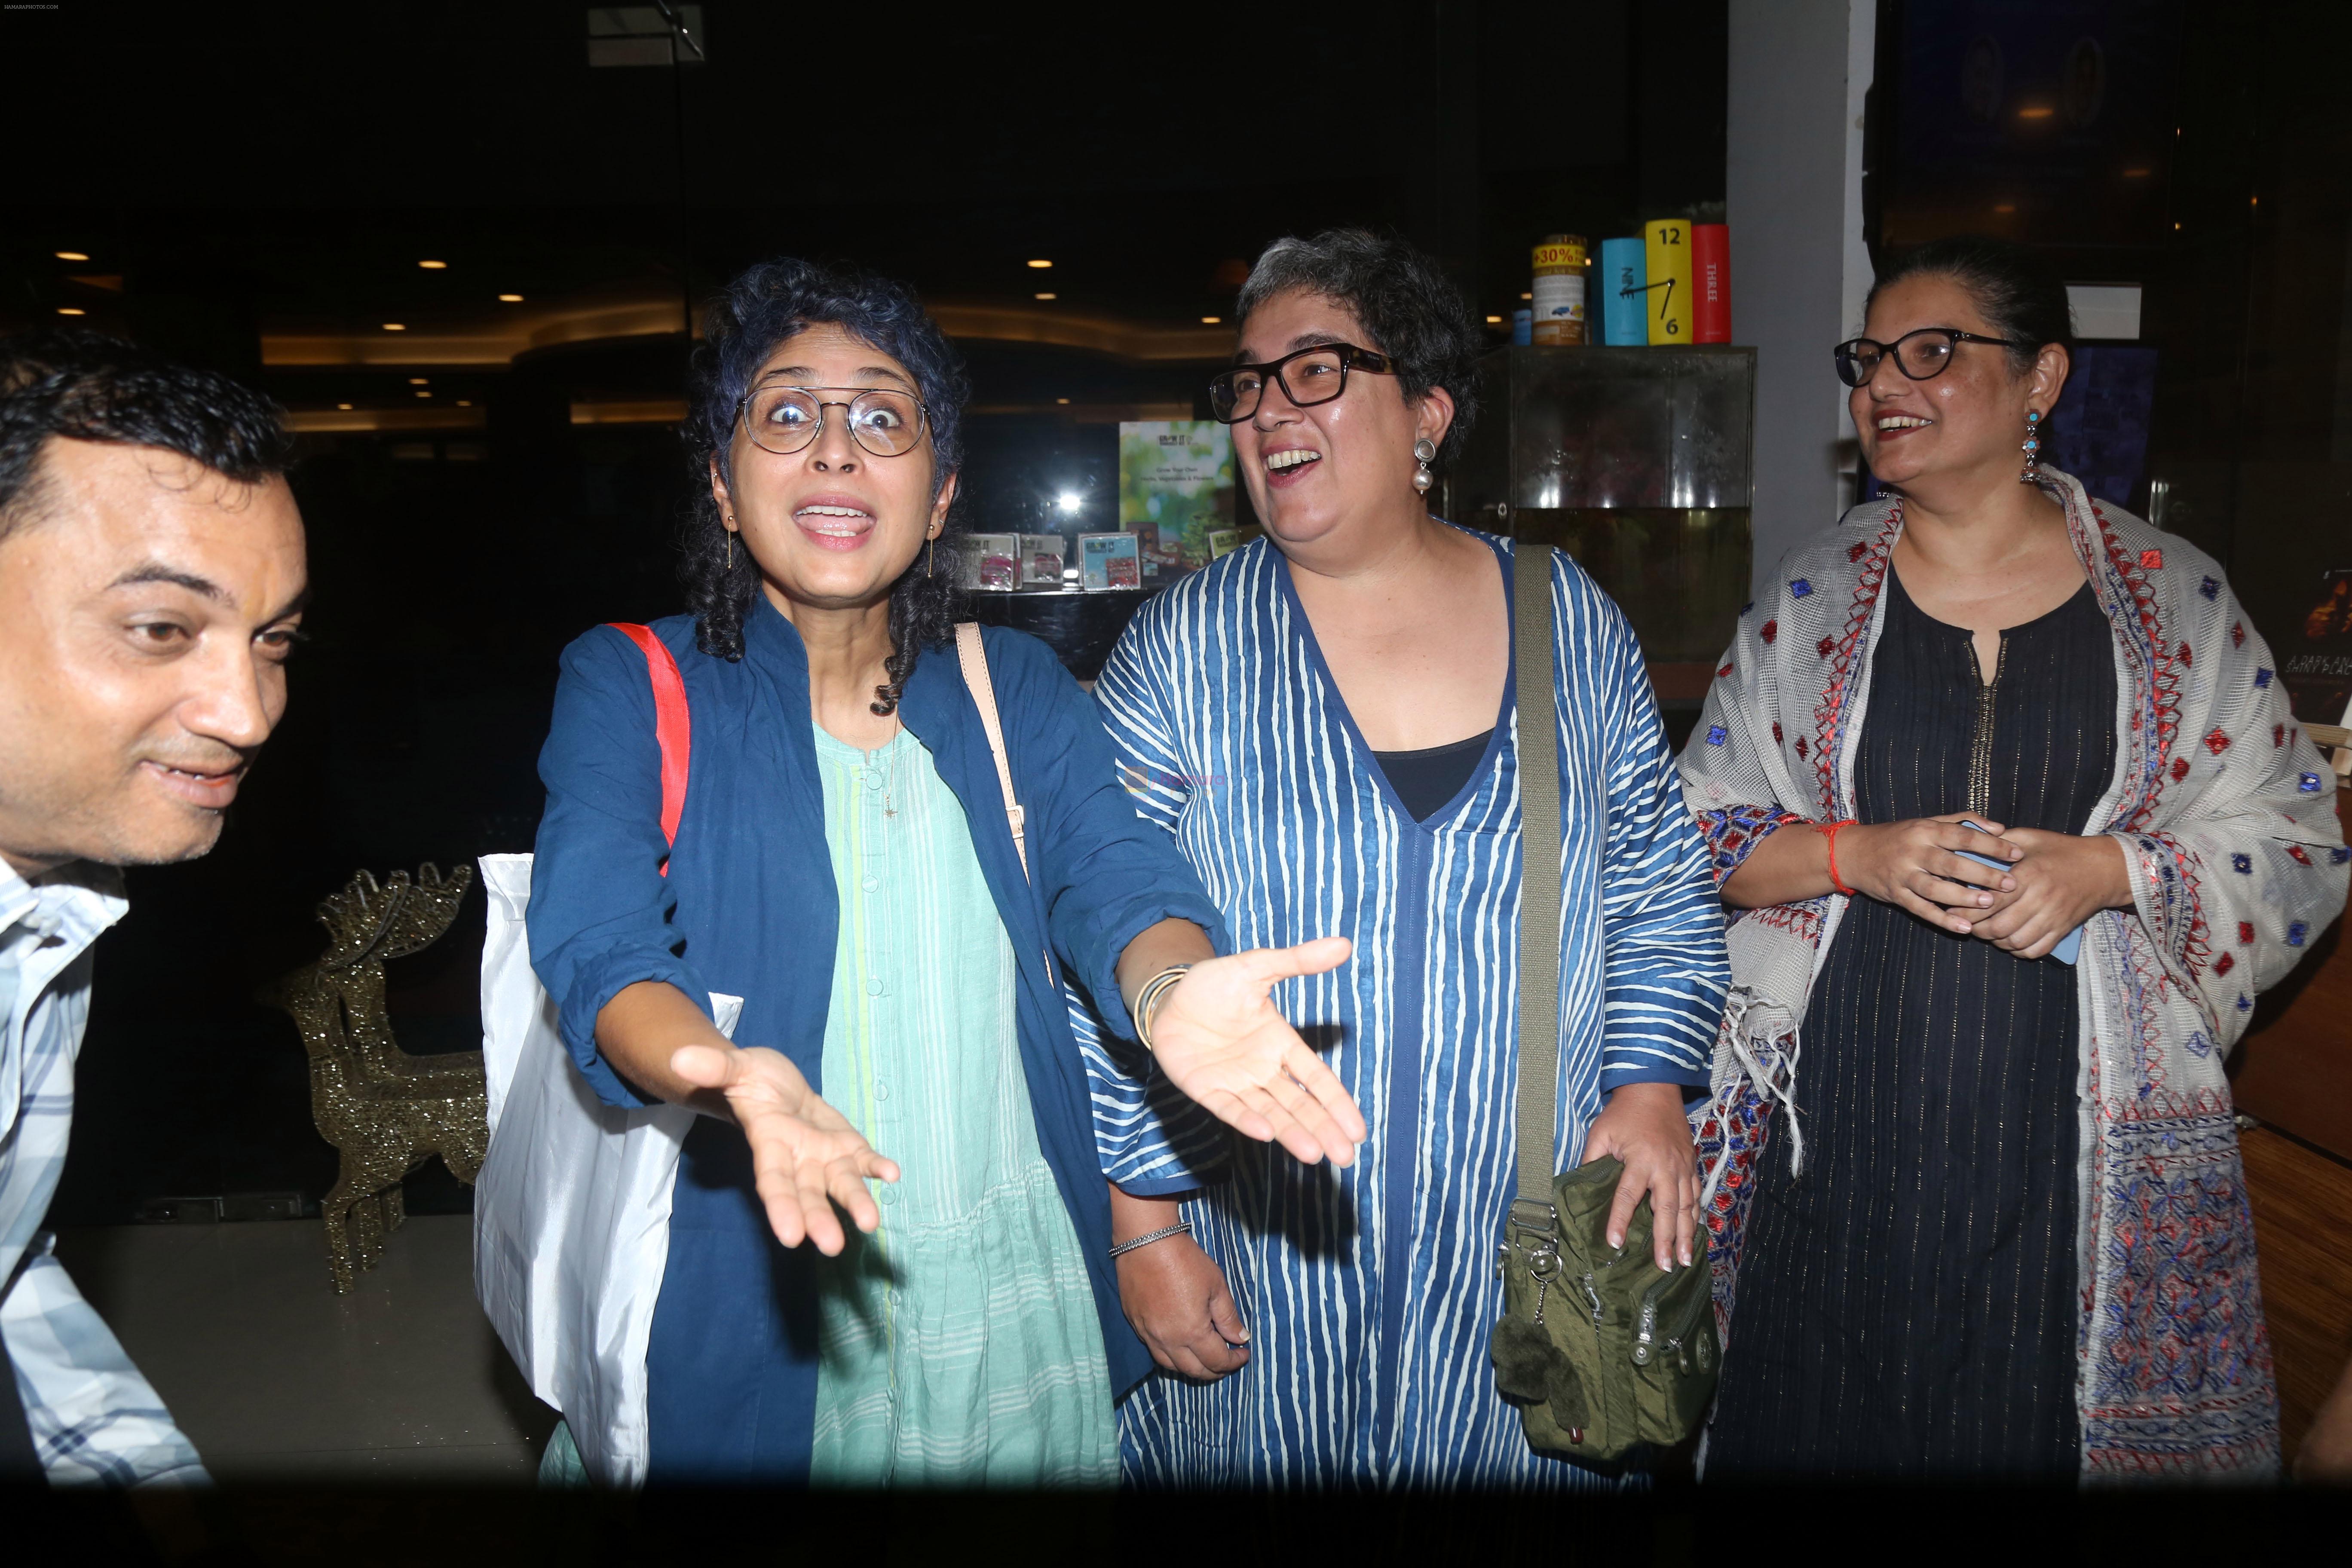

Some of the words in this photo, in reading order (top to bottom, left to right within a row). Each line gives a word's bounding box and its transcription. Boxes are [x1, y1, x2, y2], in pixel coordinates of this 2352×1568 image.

[1659, 228, 1680, 245] 12
[1535, 248, 1573, 263] +30%
[1621, 267, 1635, 300] NINE
[1706, 262, 1718, 303] THREE
[1666, 318, 1678, 335] 6
[2285, 662, 2320, 674] SHINY
[2290, 655, 2297, 665] A
[2300, 655, 2330, 665] DARK
[2333, 656, 2352, 665] AN
